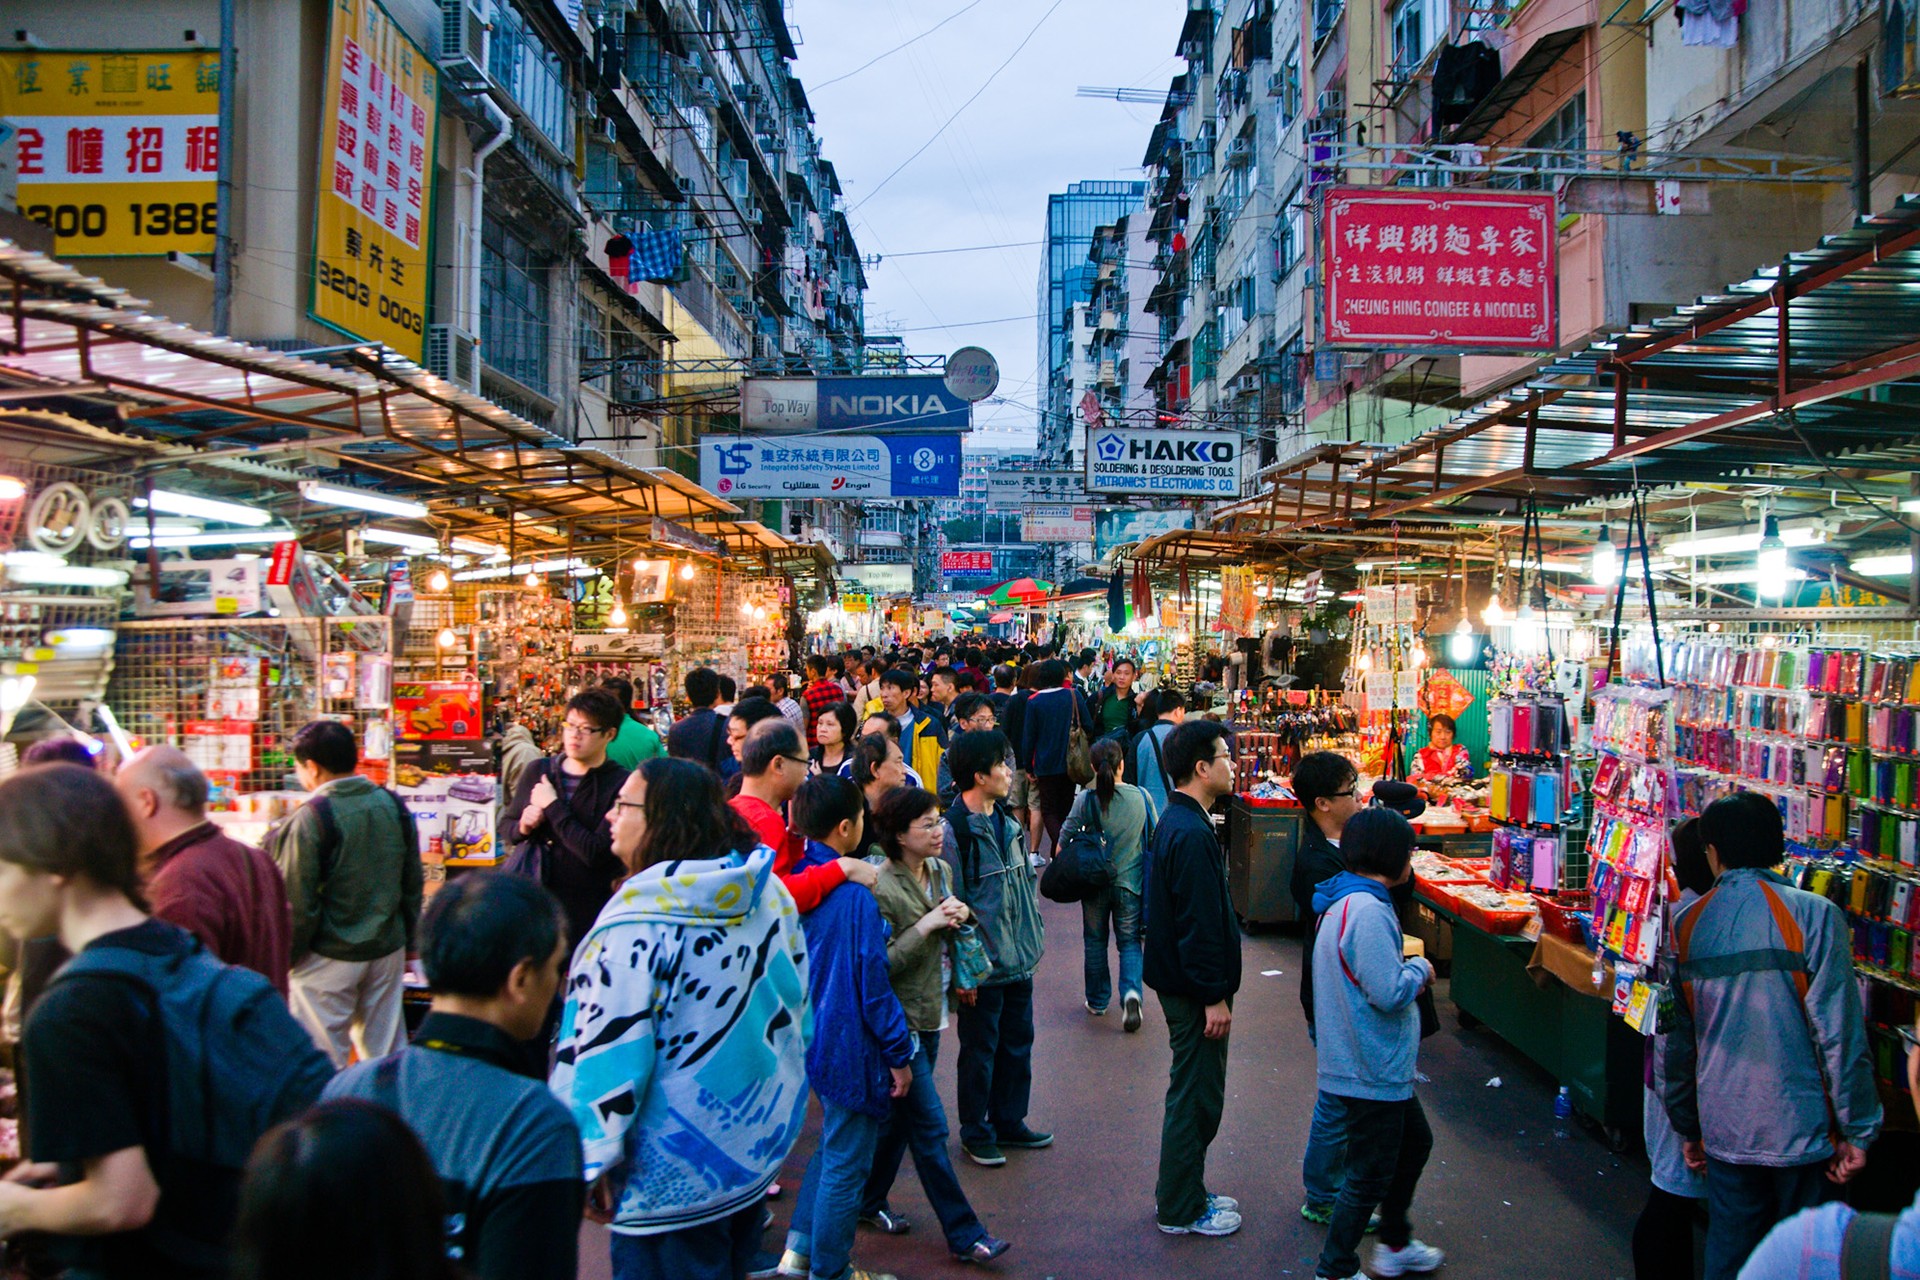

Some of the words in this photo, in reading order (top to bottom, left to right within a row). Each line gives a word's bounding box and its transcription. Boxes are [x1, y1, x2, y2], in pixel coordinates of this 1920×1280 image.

[18, 126, 219, 174] 全幢招租
[17, 204, 107, 237] 300
[379, 294, 422, 336] 0003
[1344, 298, 1390, 315] CHEUNG
[1392, 299, 1421, 316] HING
[1424, 300, 1470, 317] CONGEE
[1473, 301, 1482, 317] &
[1485, 301, 1537, 319] NOODLES
[763, 400, 785, 416] Top
[787, 400, 810, 416] Way
[830, 394, 948, 416] NOKIA
[761, 448, 880, 463] 集安系統有限公司
[1129, 439, 1234, 463] HAKKO
[760, 463, 799, 472] Integrated
[800, 463, 824, 472] Safety
[825, 463, 851, 472] System
[852, 463, 880, 471] Limited
[1094, 462, 1138, 474] SOLDERING
[1141, 464, 1147, 475] &
[1150, 464, 1204, 477] DESOLDERING
[736, 482, 746, 490] LG
[748, 483, 772, 491] Security
[1094, 475, 1147, 488] PATRONICS
[1150, 477, 1216, 490] ELECTRONICS
[1219, 479, 1235, 491] CO.
